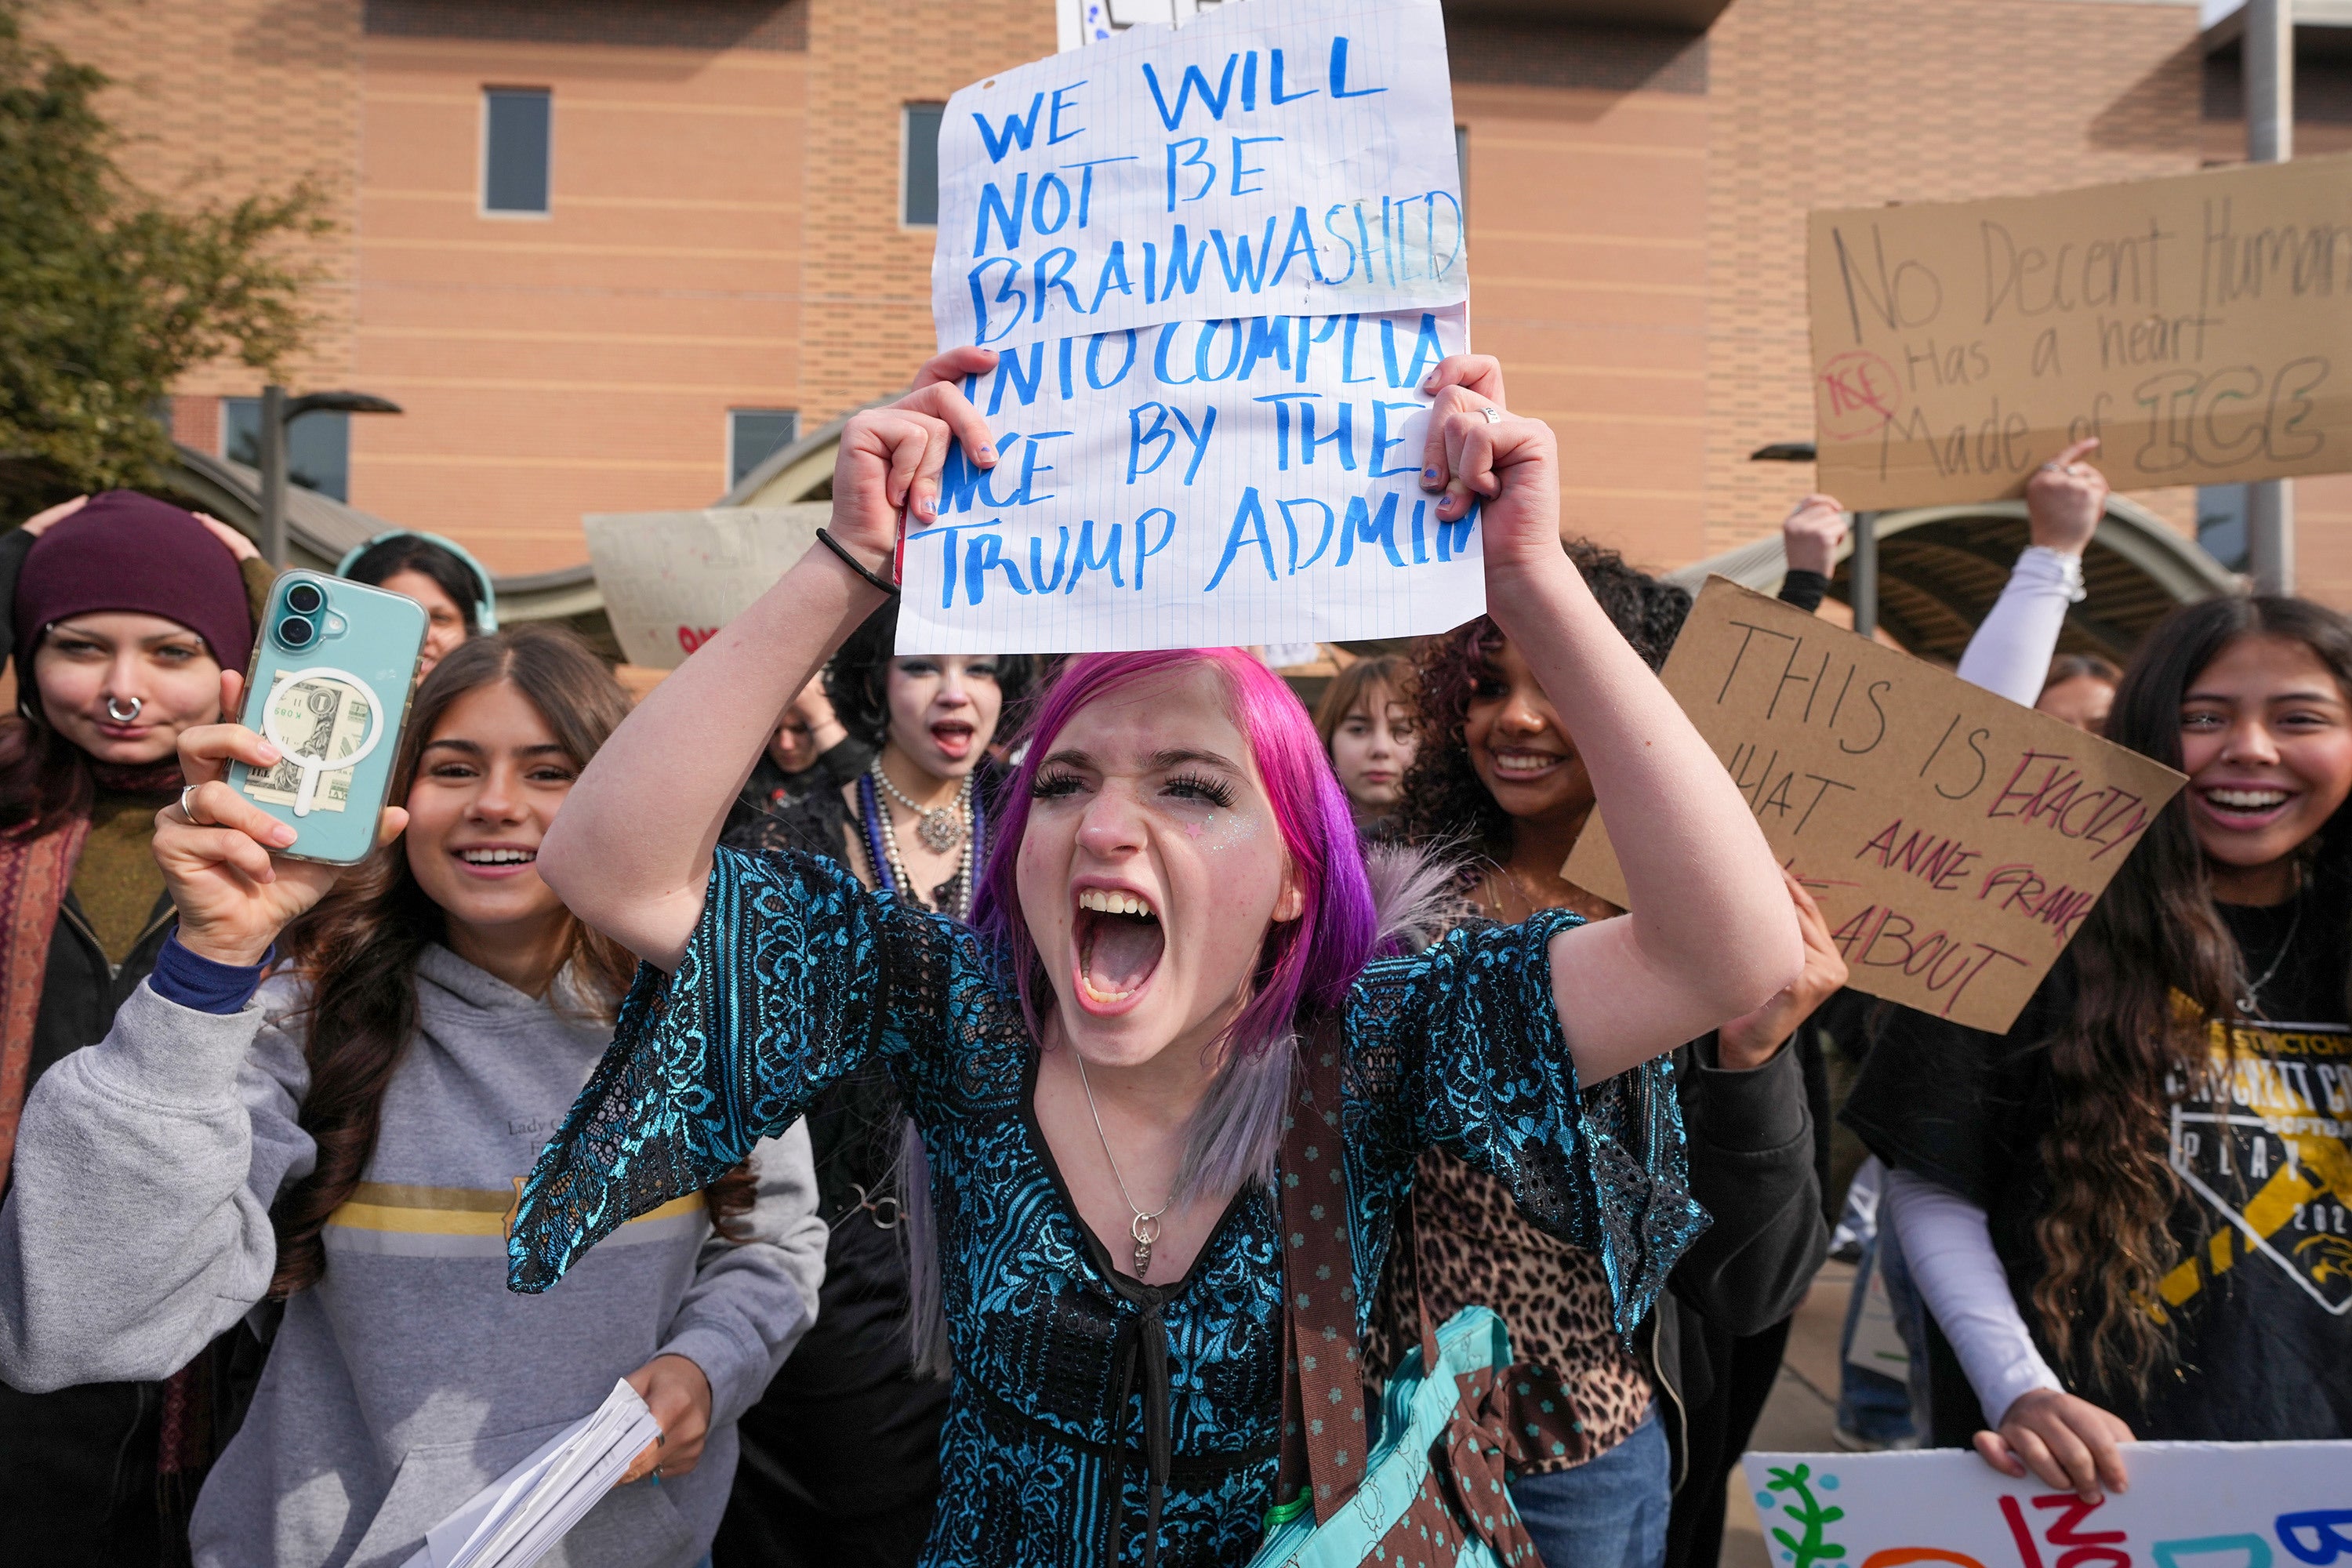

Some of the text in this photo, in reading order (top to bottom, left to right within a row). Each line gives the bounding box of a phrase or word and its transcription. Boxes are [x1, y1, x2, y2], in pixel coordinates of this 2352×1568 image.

[972, 36, 1388, 164] WE WILL
[973, 136, 1283, 258] NOT BE
[968, 191, 1462, 347] BRAINWASHED
[1832, 223, 1943, 344] No
[1980, 216, 2176, 324] Decent
[1904, 314, 2225, 391] Has a heart
[1127, 401, 1217, 486] BY
[1253, 392, 1427, 478] THE
[1879, 357, 2331, 482] Made of ICE
[908, 507, 1183, 609] TRUMP
[1716, 620, 1891, 754] THIS
[1918, 713, 1990, 800] IS
[1728, 742, 1857, 836] HAT
[1854, 816, 1984, 891] ANNE
[1978, 863, 2094, 949] FRANK
[1829, 902, 2031, 1017] ABOUT
